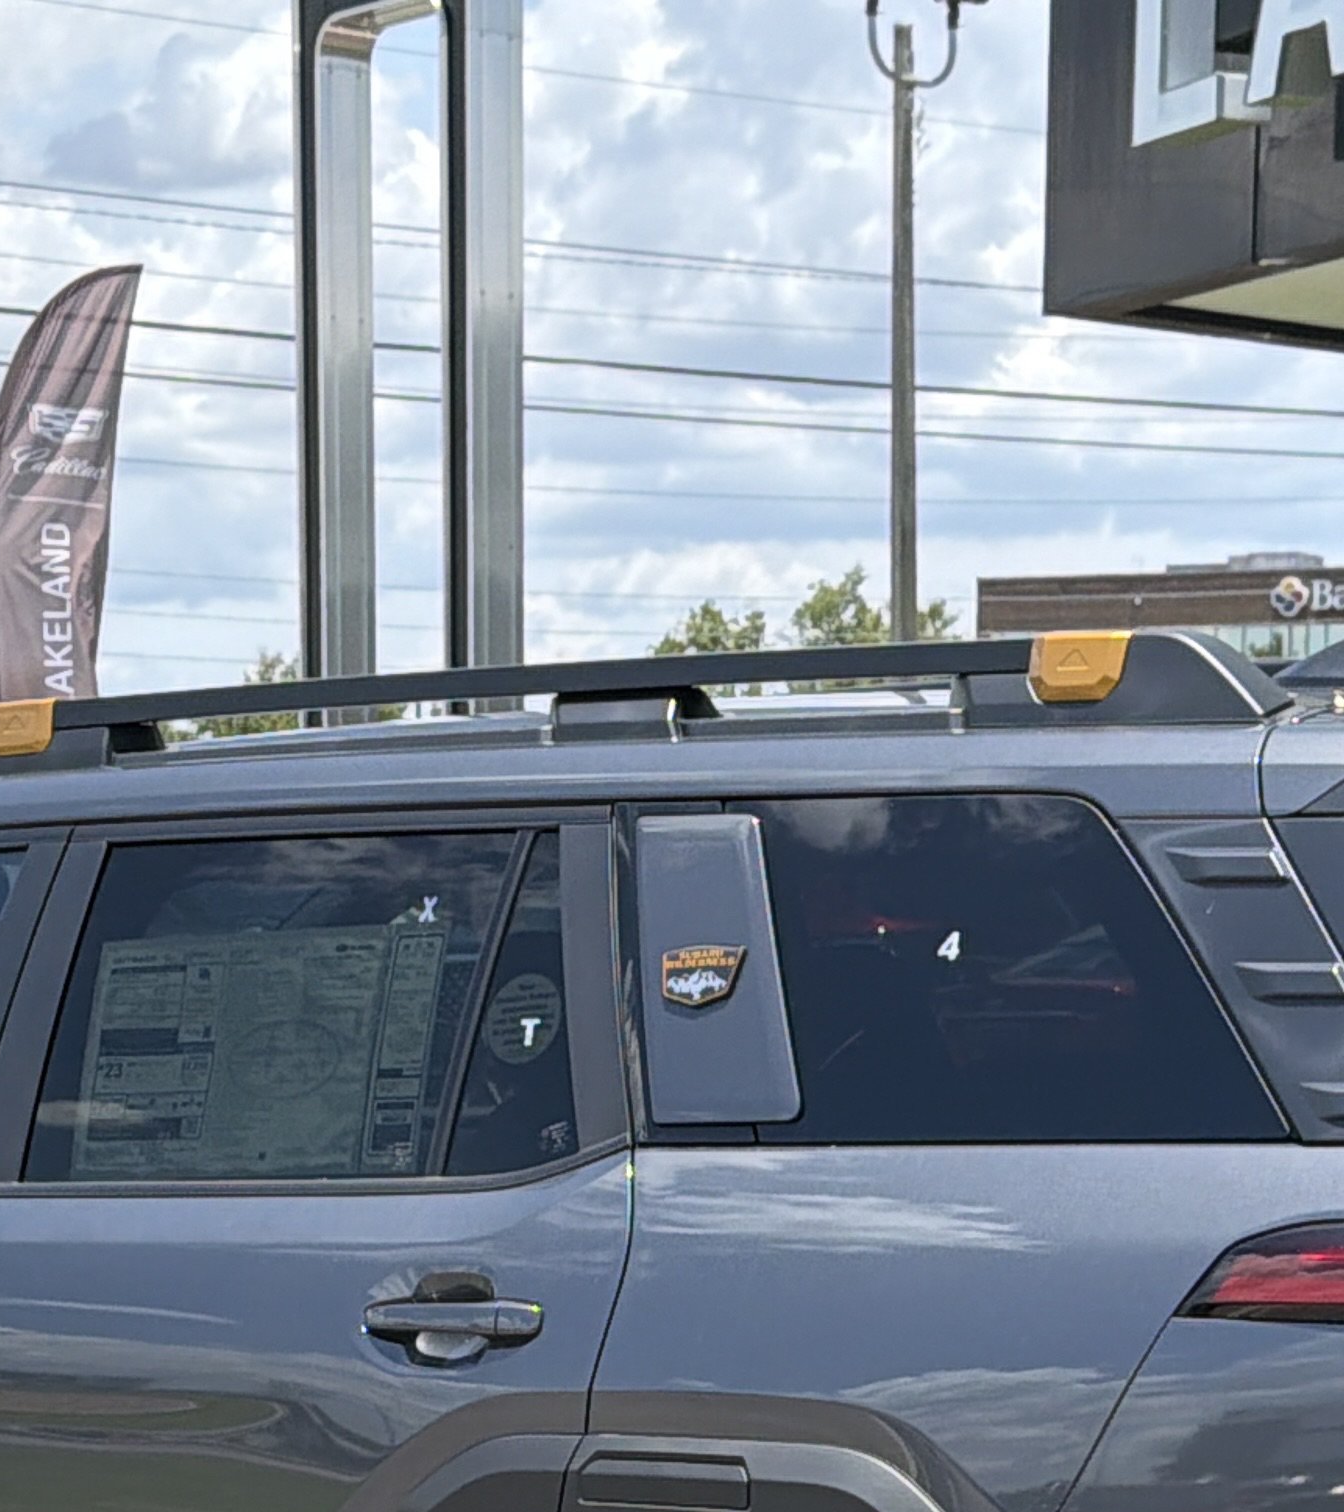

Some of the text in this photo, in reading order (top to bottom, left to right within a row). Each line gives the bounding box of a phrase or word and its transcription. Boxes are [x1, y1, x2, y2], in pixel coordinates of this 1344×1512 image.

[10, 444, 108, 480] Cadillac
[40, 522, 74, 699] AKELAND
[936, 930, 960, 962] 4
[519, 1017, 542, 1047] T
